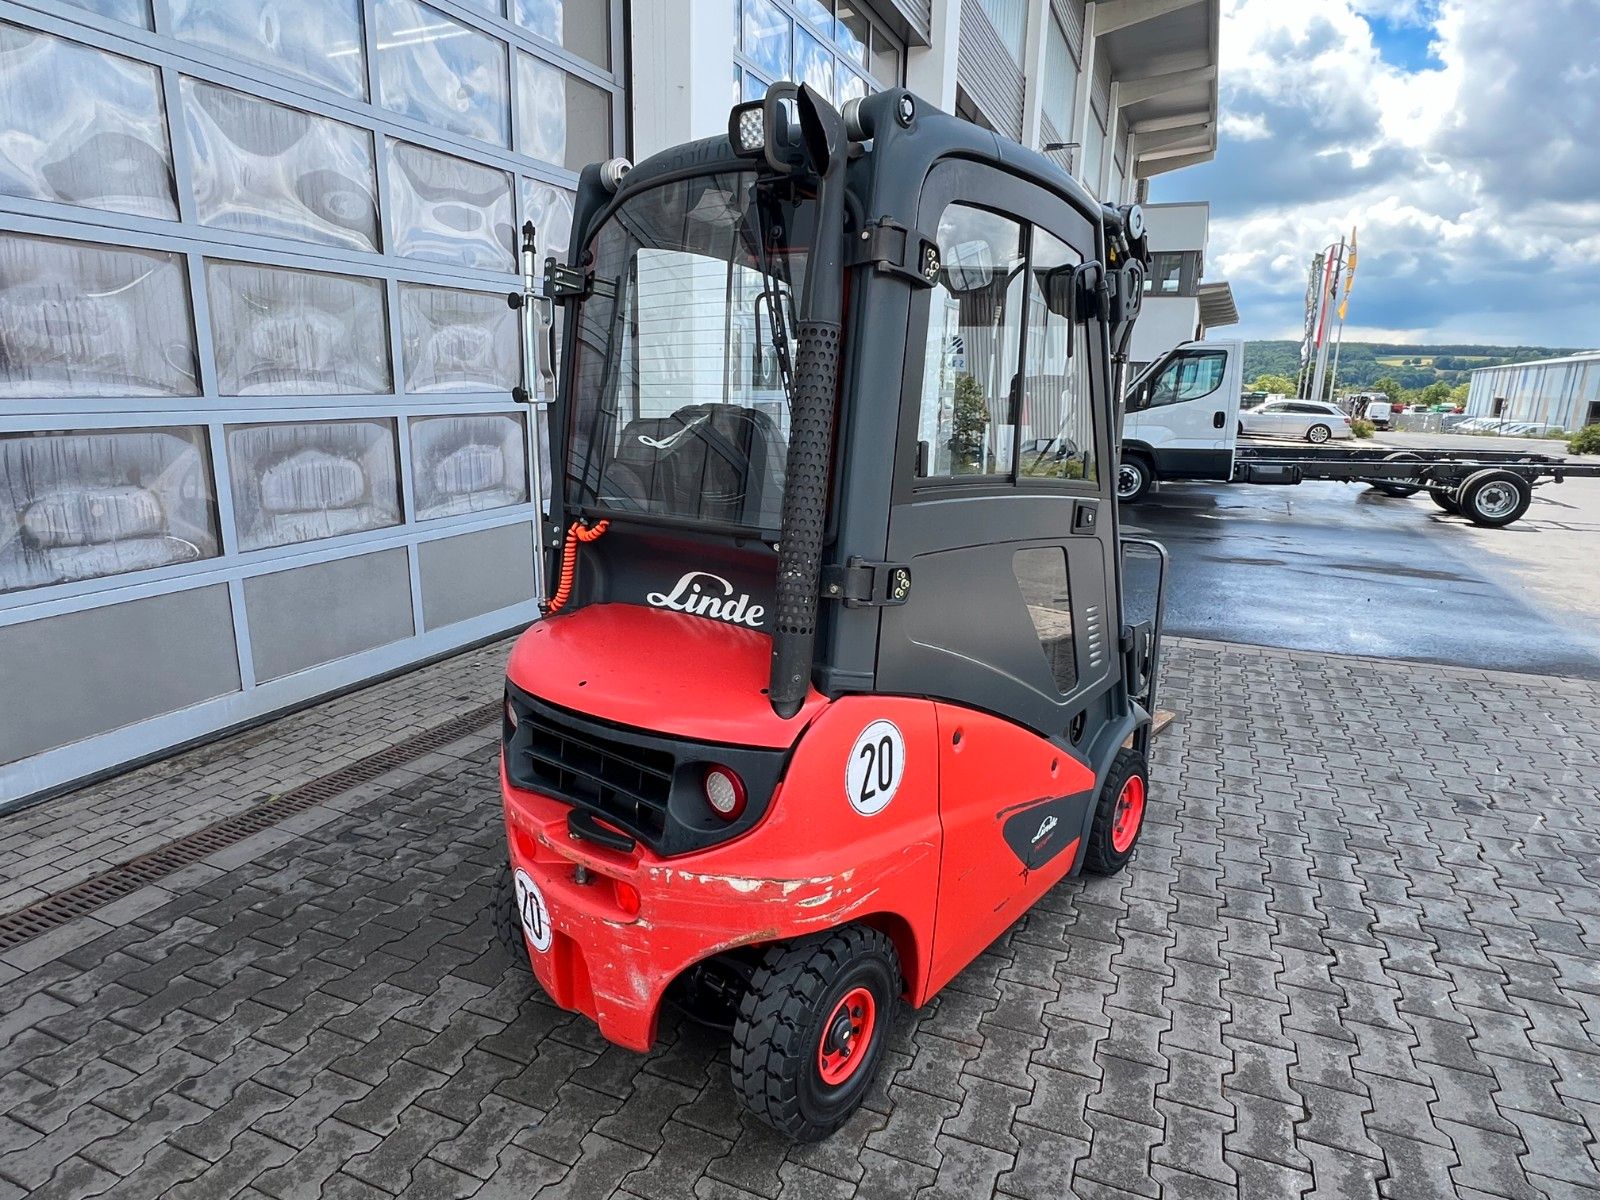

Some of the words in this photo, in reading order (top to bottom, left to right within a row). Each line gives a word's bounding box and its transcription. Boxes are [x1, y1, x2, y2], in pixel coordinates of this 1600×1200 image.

[647, 571, 765, 627] Linde
[860, 735, 893, 803] 20
[518, 879, 543, 940] 20
